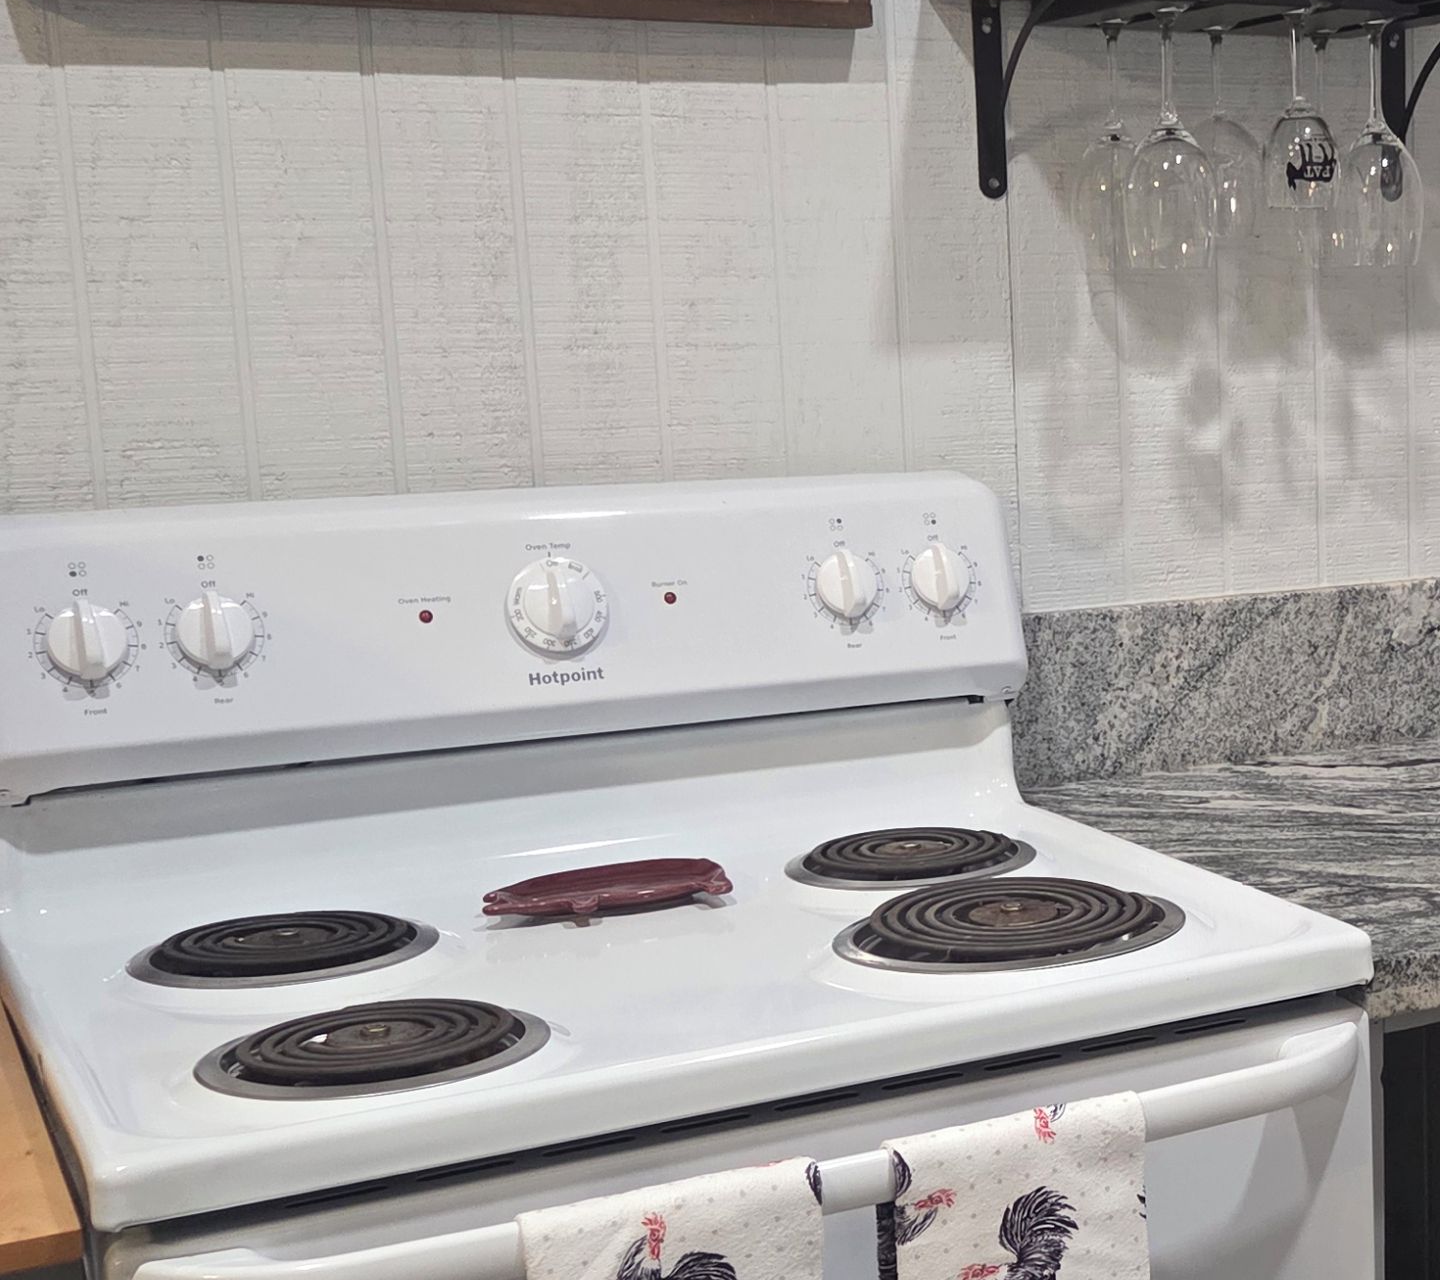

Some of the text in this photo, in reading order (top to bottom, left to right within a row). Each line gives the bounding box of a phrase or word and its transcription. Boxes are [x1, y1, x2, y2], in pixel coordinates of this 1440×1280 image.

[1303, 166, 1331, 178] PAT
[550, 542, 571, 550] Temp
[201, 580, 216, 589] Off
[72, 588, 88, 597] Off
[528, 666, 605, 686] Hotpoint
[84, 708, 107, 716] Front
